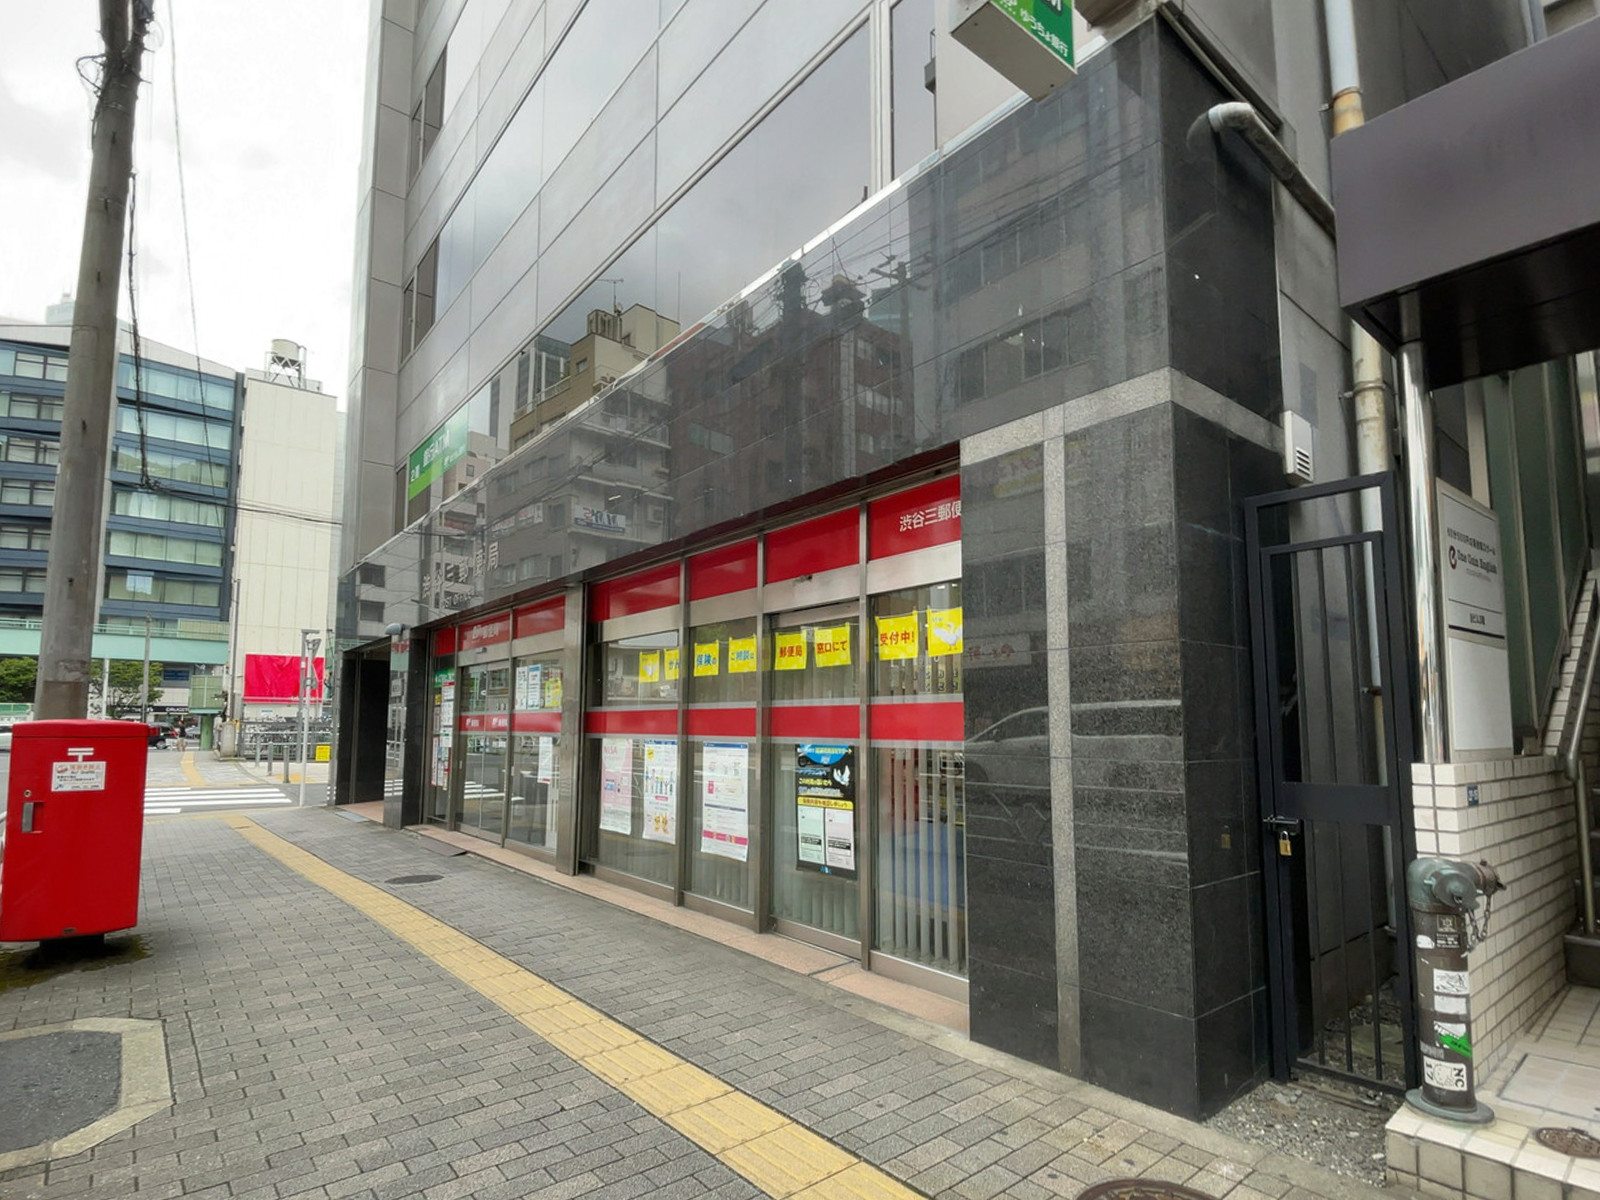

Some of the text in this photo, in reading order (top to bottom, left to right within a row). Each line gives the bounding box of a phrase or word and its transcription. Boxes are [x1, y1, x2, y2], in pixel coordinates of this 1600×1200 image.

[1020, 8, 1068, 57] ゆうちょ銀行
[899, 500, 961, 532] 渋谷三郵便
[879, 630, 915, 646] 受付中!
[779, 645, 802, 657] 郵便局
[816, 640, 848, 655] 窓口にて
[697, 653, 717, 667] 保険の
[1453, 1066, 1465, 1088] NC
